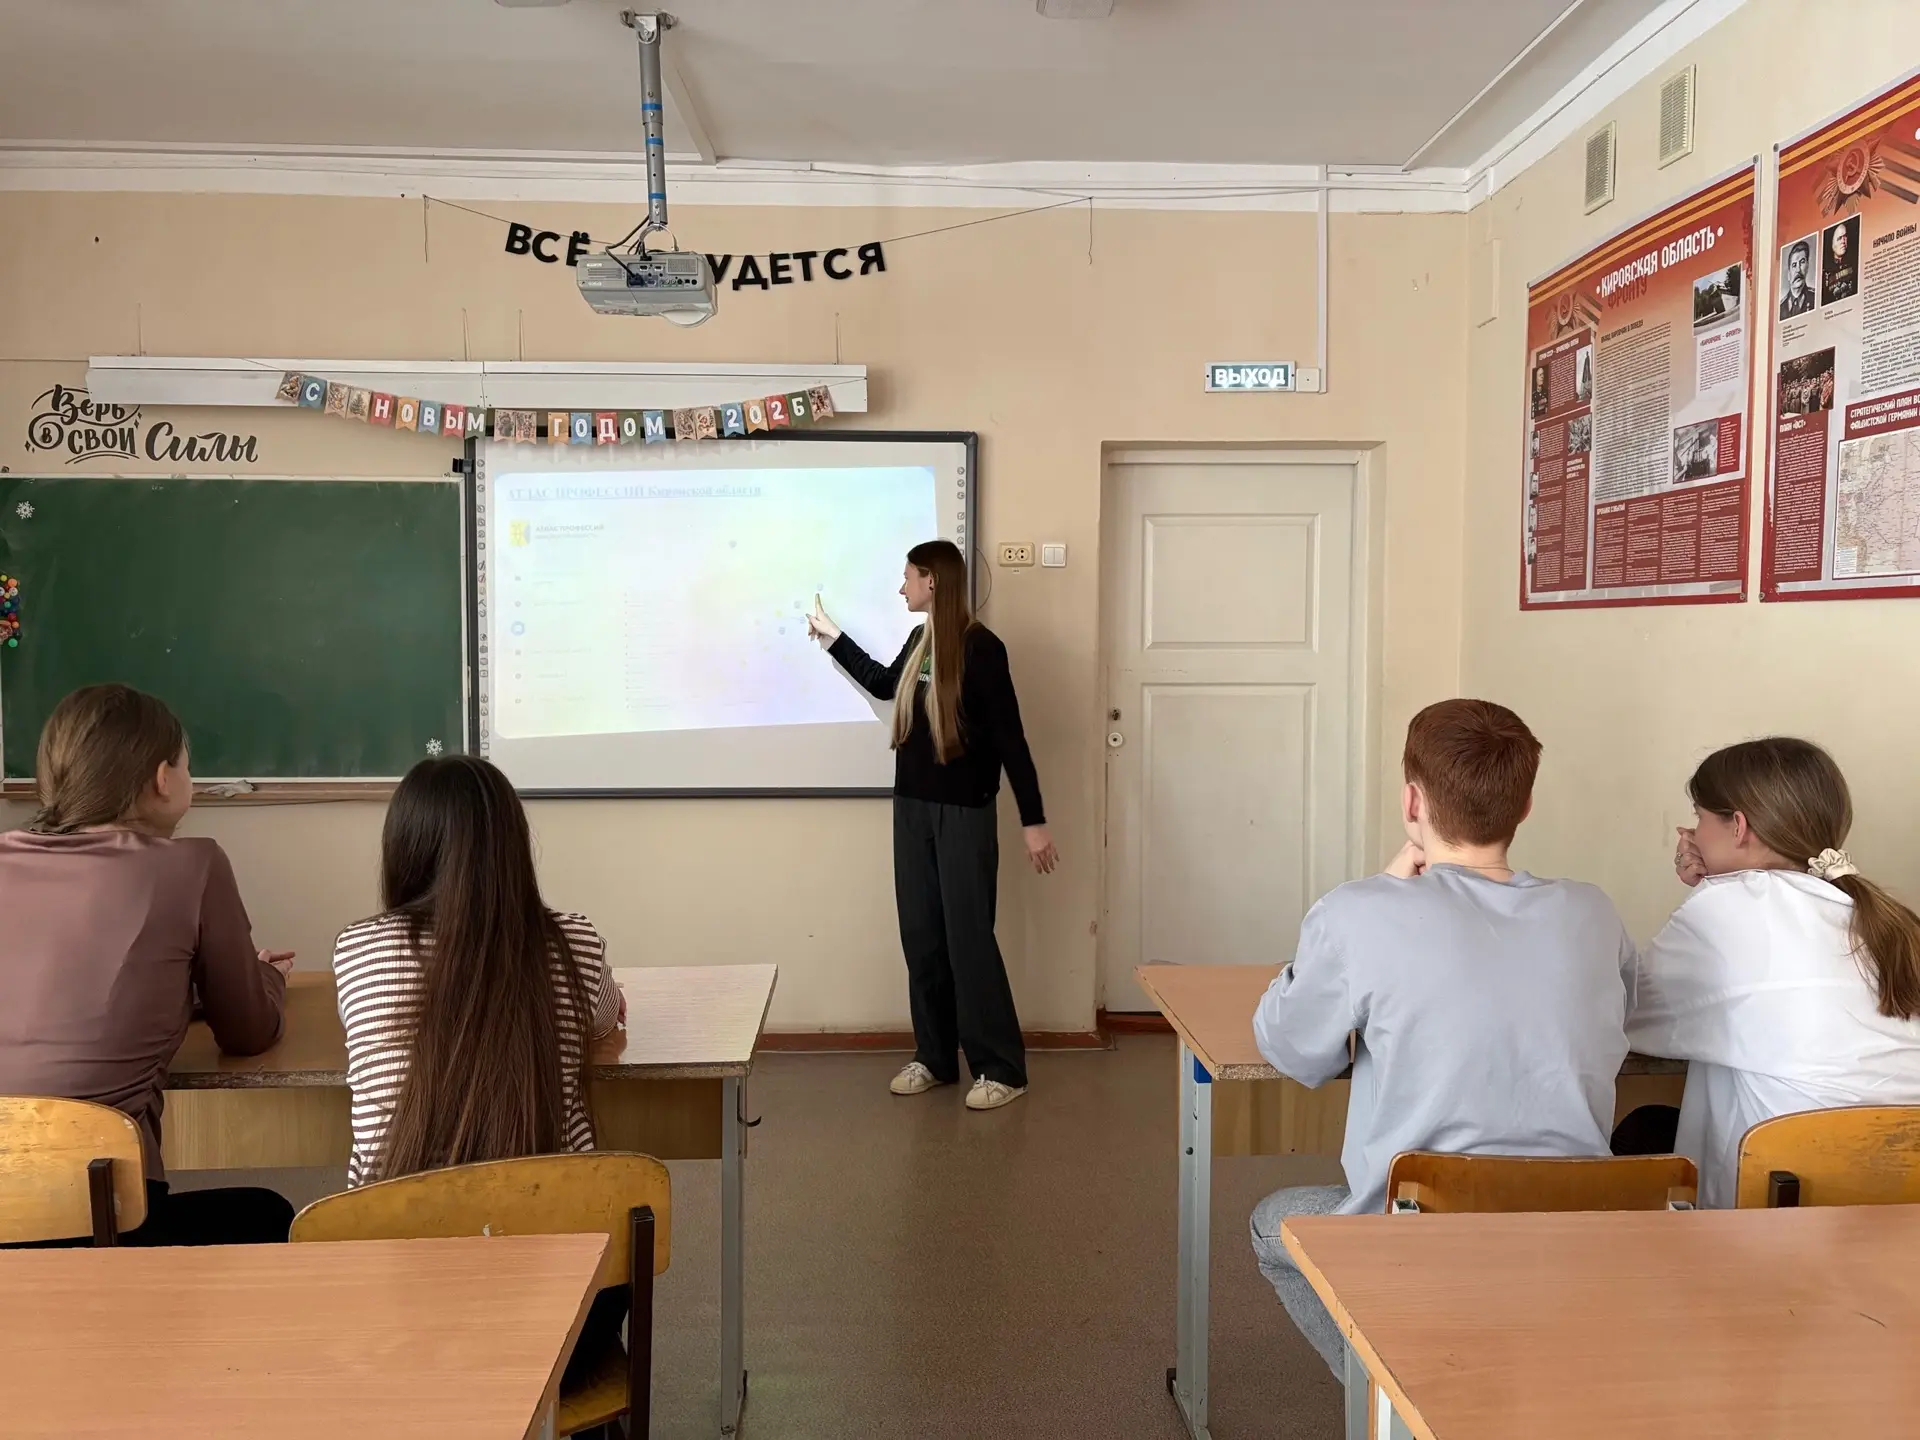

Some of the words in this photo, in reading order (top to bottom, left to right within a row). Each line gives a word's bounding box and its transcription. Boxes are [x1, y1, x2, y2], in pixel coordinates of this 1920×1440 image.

[505, 222, 592, 267] ВСЁ
[704, 241, 887, 291] УДЕТСЯ
[1601, 250, 1658, 298] КИРОВСКАЯ
[1661, 226, 1715, 268] ОБЛАСТЬ
[1215, 368, 1286, 386] ВЫХОД
[305, 382, 320, 402] С
[374, 397, 485, 433] НОВЫМ
[552, 415, 664, 442] ГОДОМ
[726, 396, 806, 429] 2026
[1850, 398, 1896, 419] СТРАТЕГИЧЕСКИЙ
